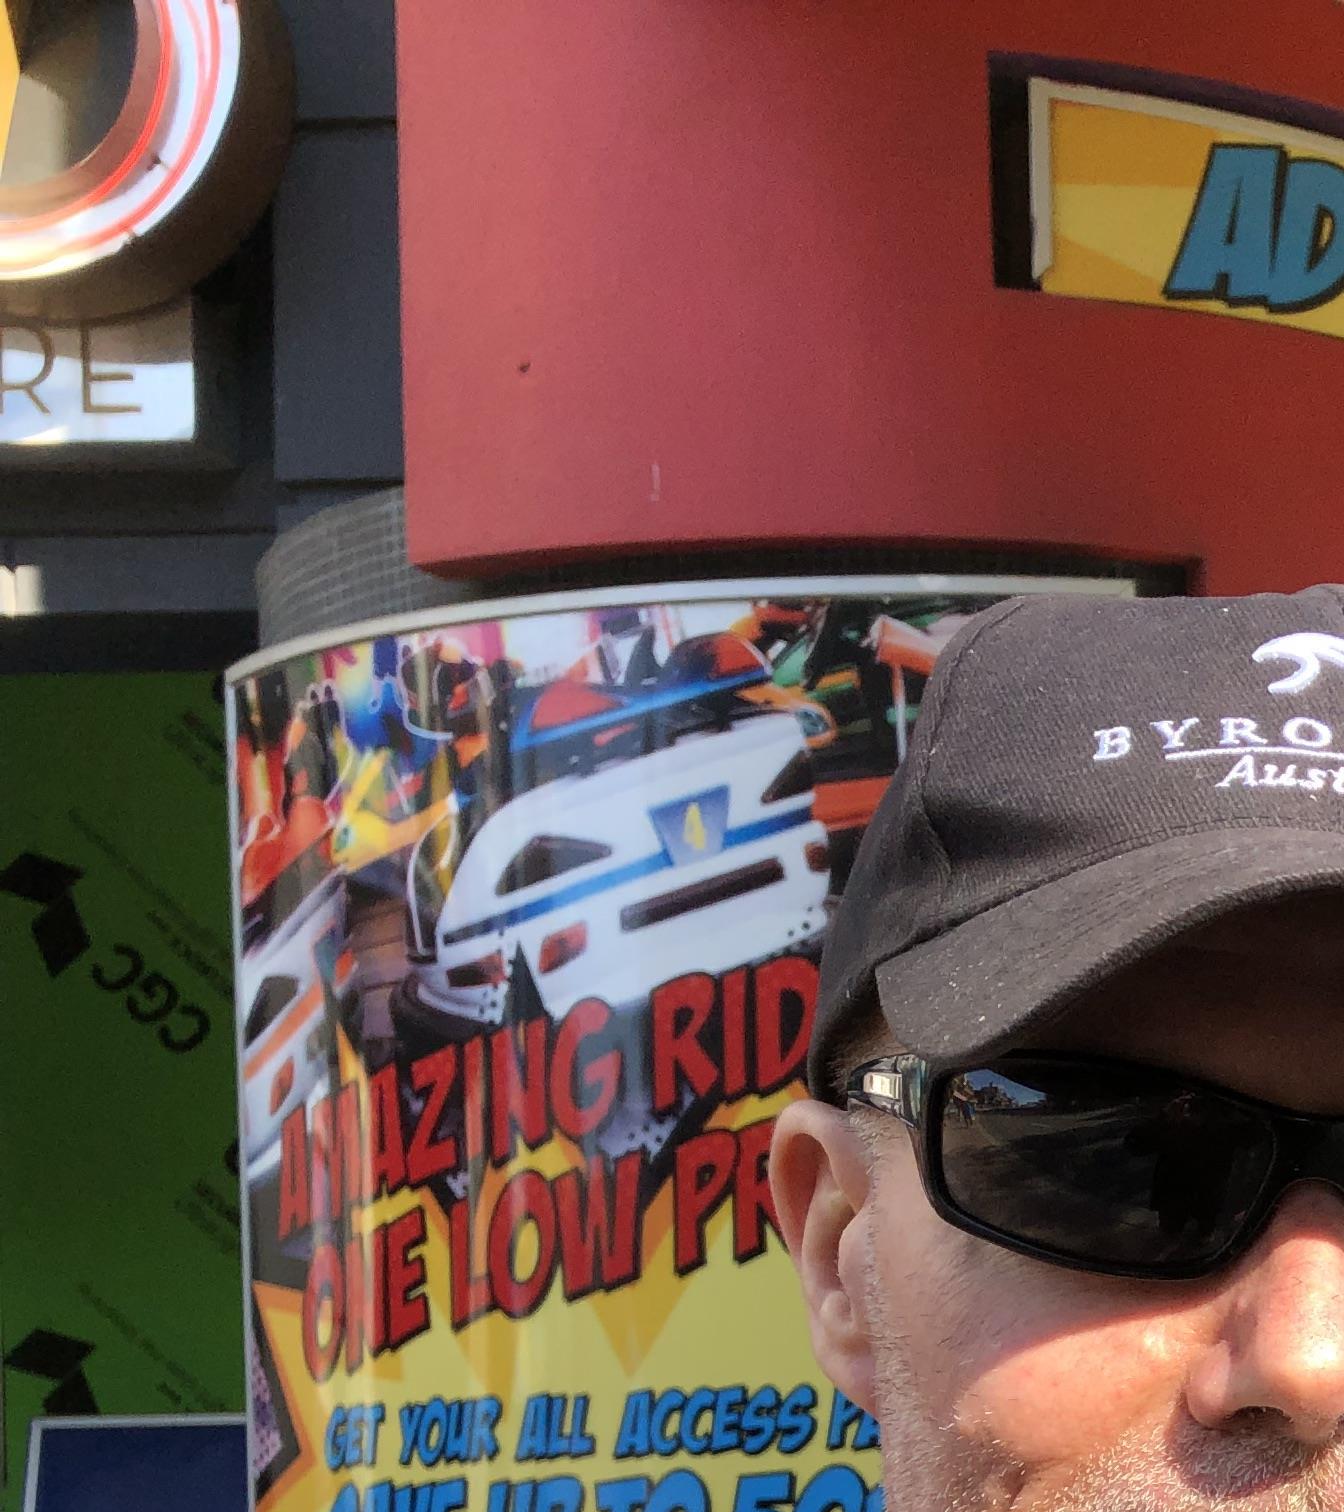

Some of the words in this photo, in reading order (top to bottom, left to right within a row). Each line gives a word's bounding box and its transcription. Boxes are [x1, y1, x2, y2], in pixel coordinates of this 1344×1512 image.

[278, 997, 623, 1242] AMAZING
[301, 1202, 431, 1383] ONE
[450, 1148, 646, 1332] LOW
[323, 1402, 383, 1471] GET
[399, 1393, 501, 1468] YOUR
[515, 1391, 597, 1463] ALL
[614, 1384, 818, 1459] ACCESS
